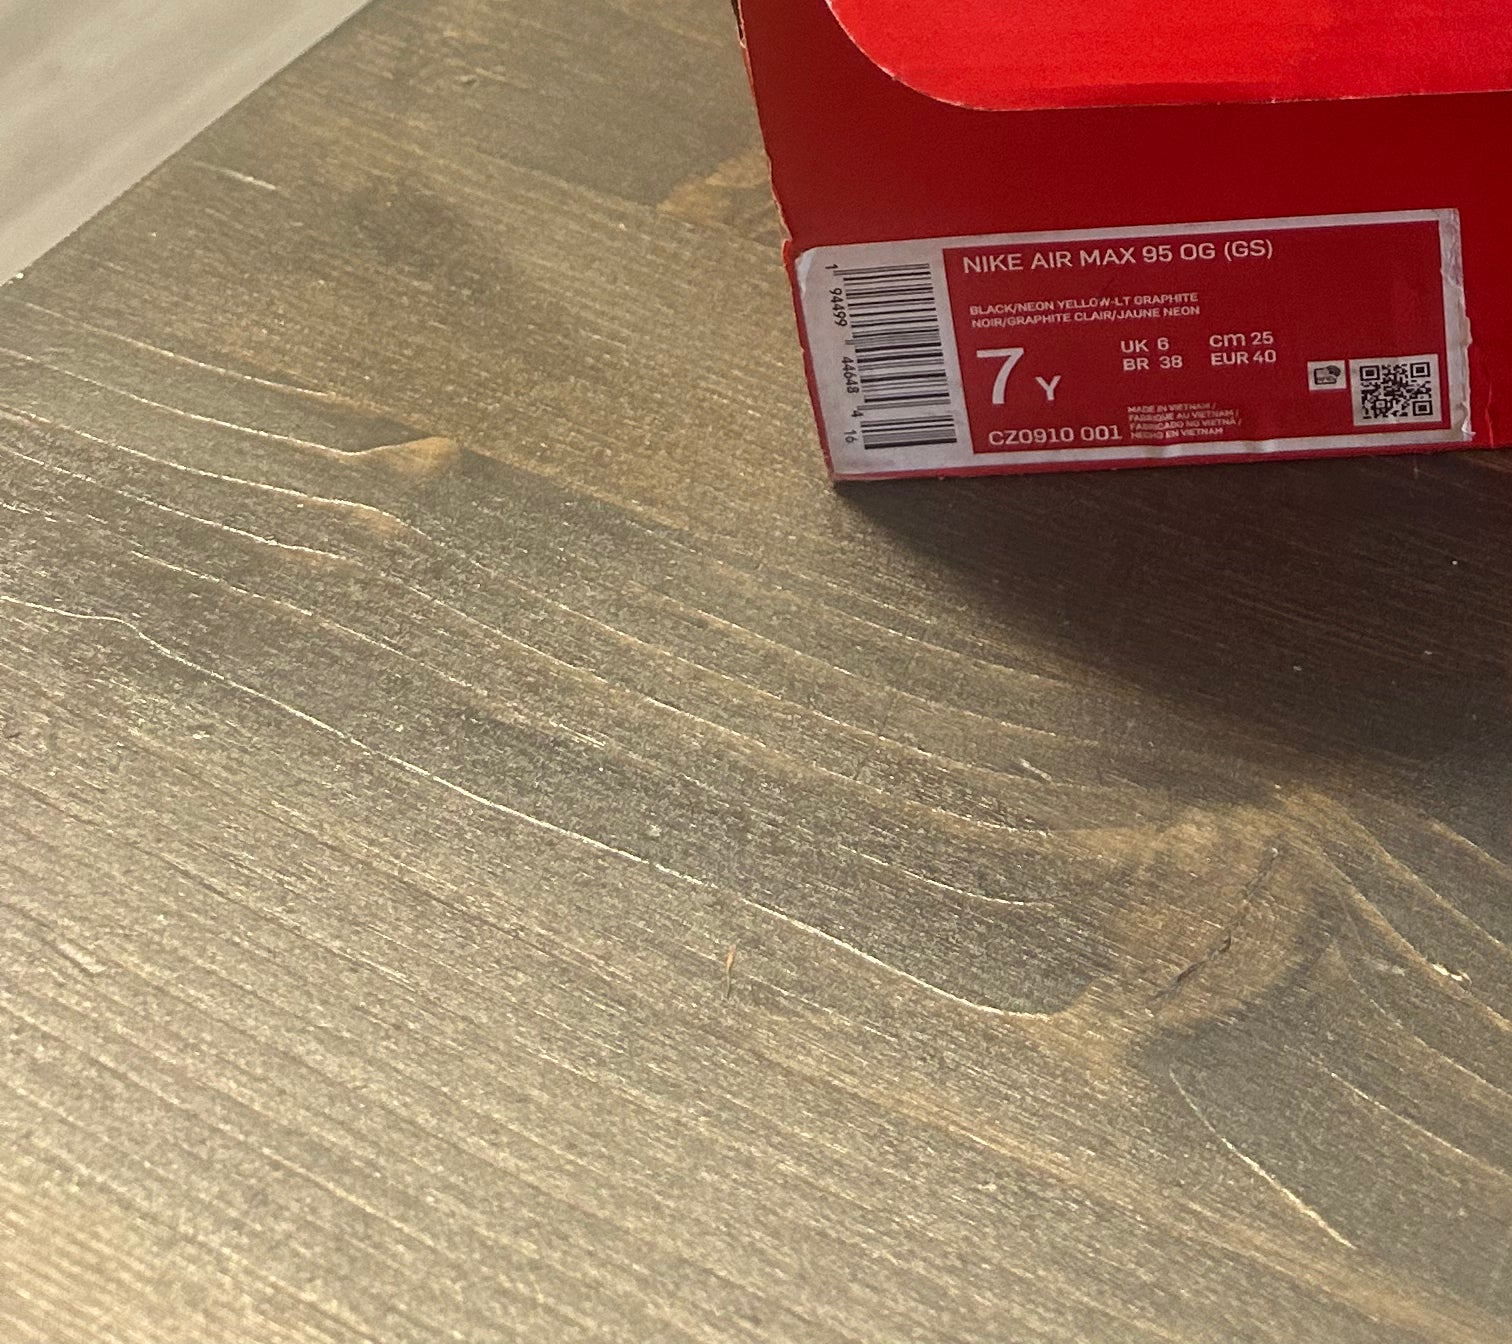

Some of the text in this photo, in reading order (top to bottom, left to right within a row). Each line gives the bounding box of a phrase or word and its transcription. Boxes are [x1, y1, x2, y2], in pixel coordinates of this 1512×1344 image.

[963, 239, 1273, 273] NIKE AIR MAX 95 OG (GS)
[969, 292, 1198, 316] BLACK/NEON YELLOW-LT GRAPHITE
[972, 305, 1201, 329] NOIR/GRAPHITE CLAIR/JAUNE NEON
[829, 287, 848, 327] 94499
[841, 356, 860, 394] 44648
[1120, 337, 1169, 354] UK 6
[1250, 331, 1274, 346] 25
[1122, 355, 1183, 372] BR 38
[1210, 349, 1277, 366] EUR 40
[976, 346, 1062, 405] 7 Y
[988, 424, 1123, 446] CZ0910 001
